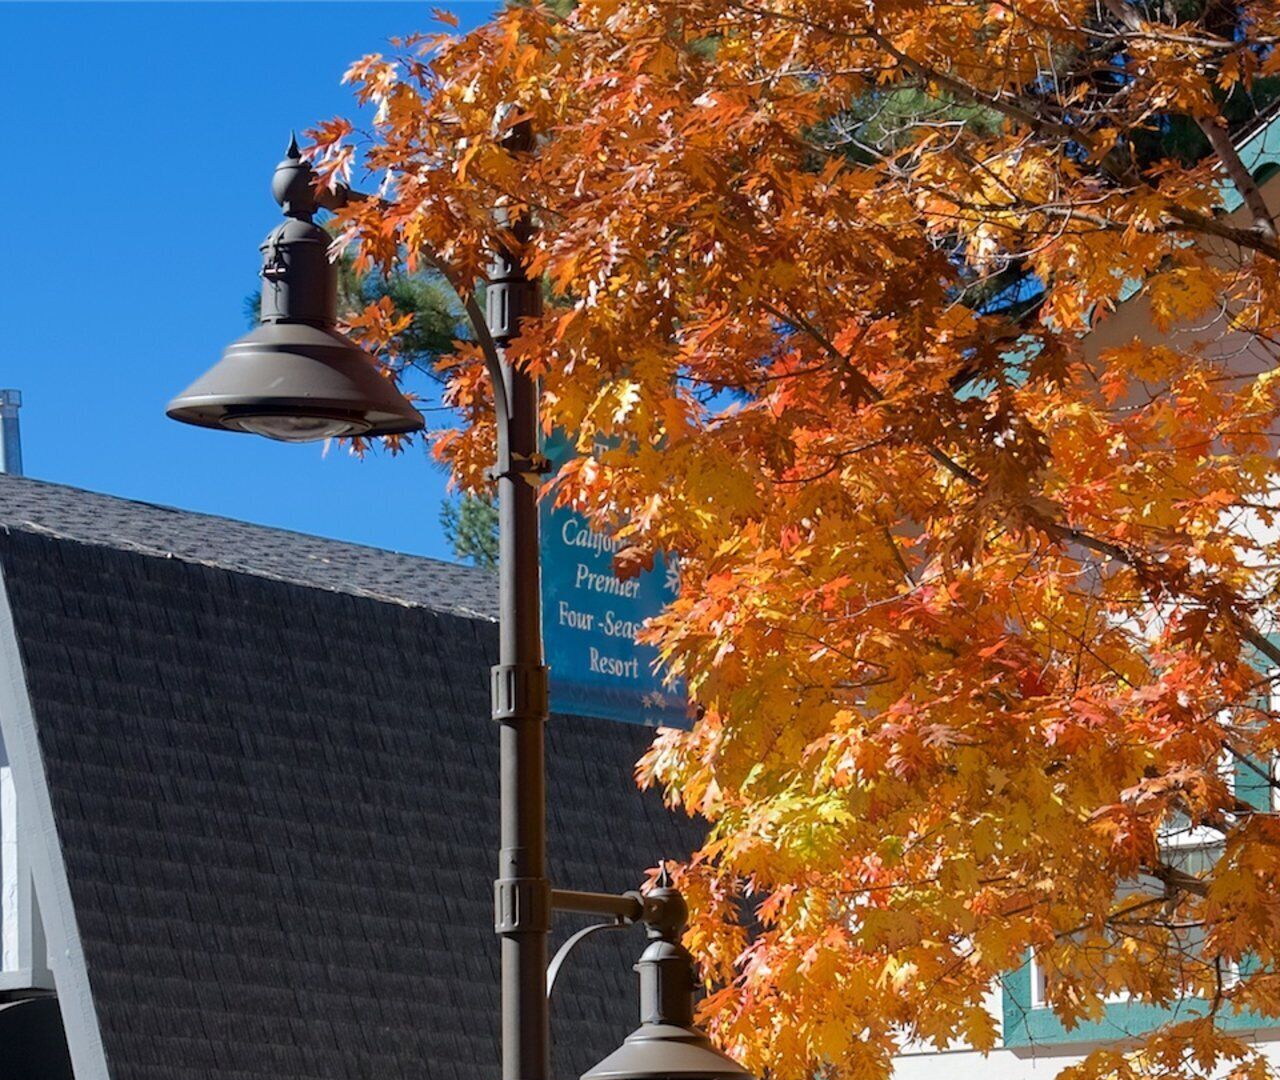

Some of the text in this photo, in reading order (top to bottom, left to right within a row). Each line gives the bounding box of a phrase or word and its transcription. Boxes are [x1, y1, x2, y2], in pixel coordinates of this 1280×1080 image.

[575, 563, 641, 599] Premier
[559, 601, 594, 631] Four
[589, 647, 639, 678] Resort
